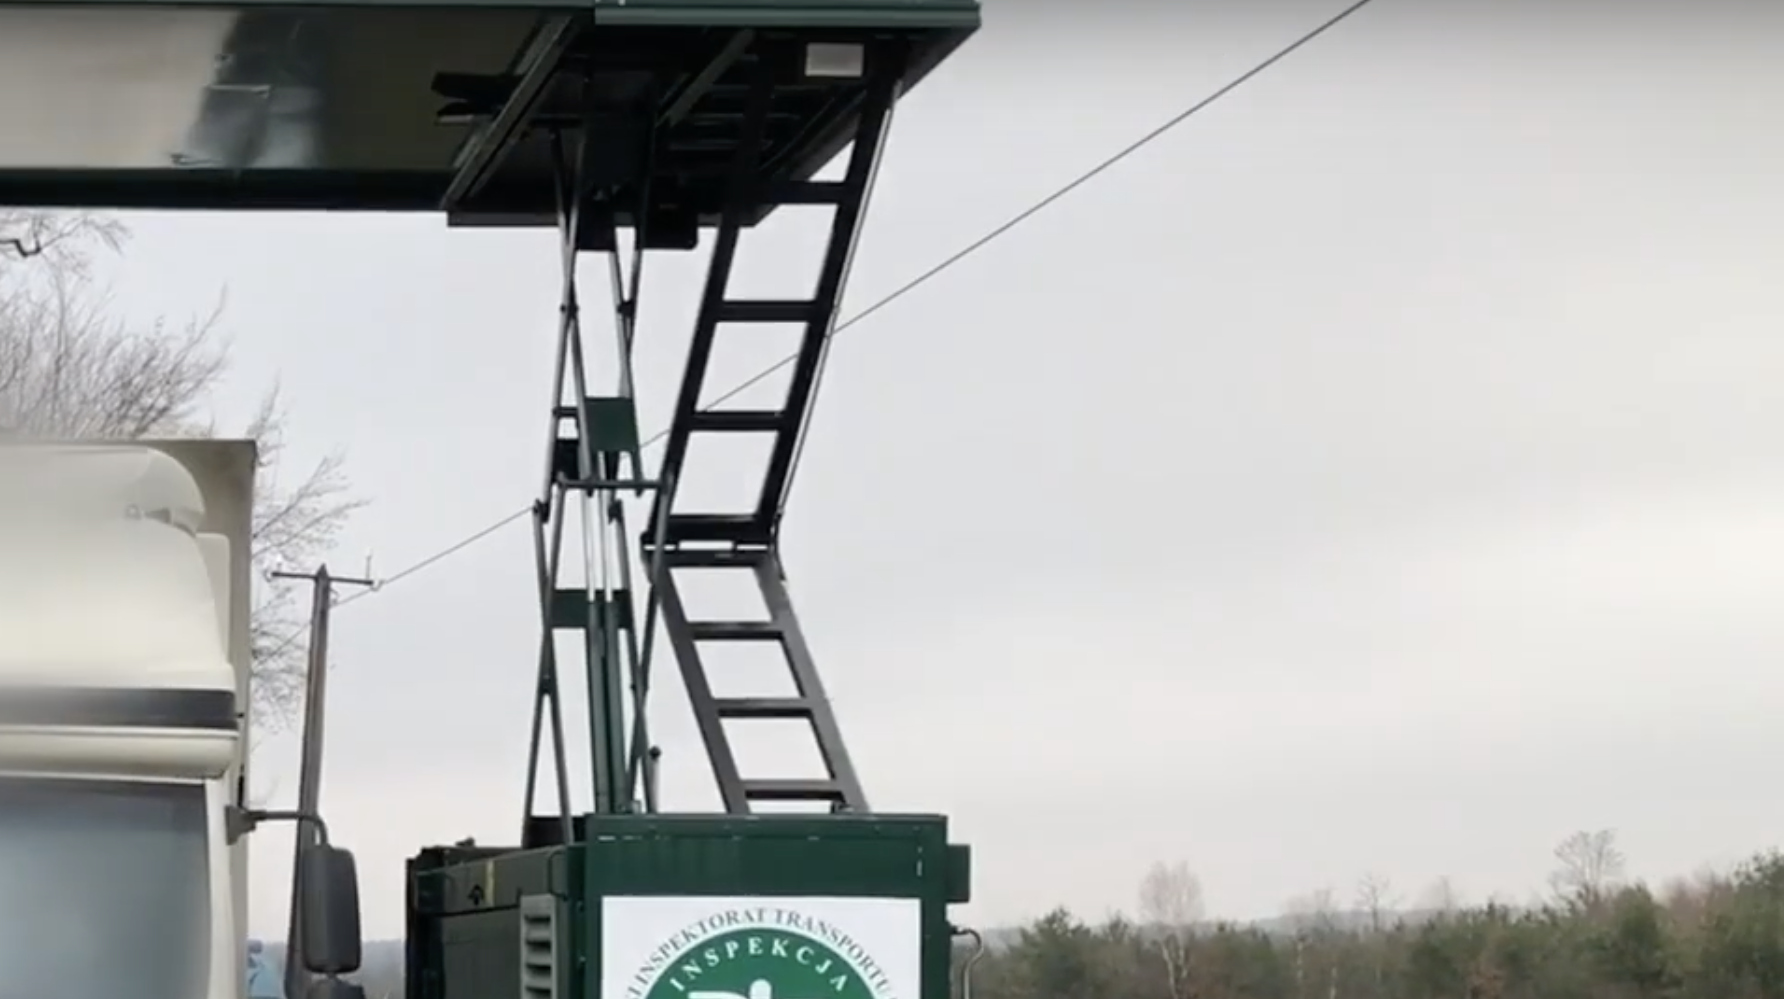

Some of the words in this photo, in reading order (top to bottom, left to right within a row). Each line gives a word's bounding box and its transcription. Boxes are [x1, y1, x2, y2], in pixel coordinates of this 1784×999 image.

[634, 908, 765, 985] INSPEKTORAT
[775, 908, 890, 994] TRANSPORTU
[669, 935, 848, 992] INSPEKCJA
